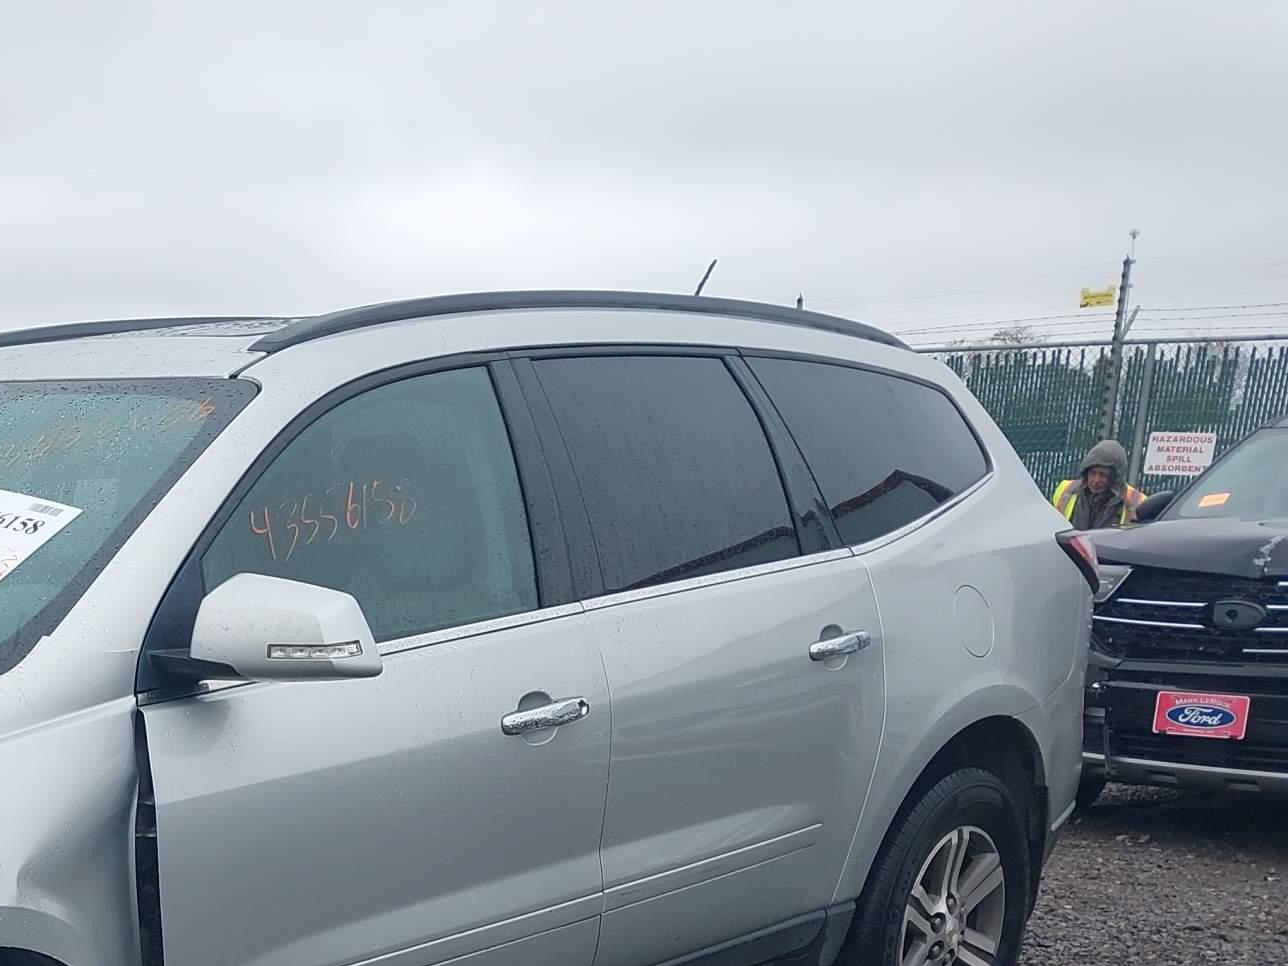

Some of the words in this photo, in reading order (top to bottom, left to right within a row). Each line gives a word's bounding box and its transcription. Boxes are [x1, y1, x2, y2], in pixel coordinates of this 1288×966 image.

[1152, 436, 1213, 444] HAZARDOUS
[1156, 446, 1205, 454] MATERIAL
[249, 478, 417, 561] 43556158
[1178, 706, 1223, 725] Ford
